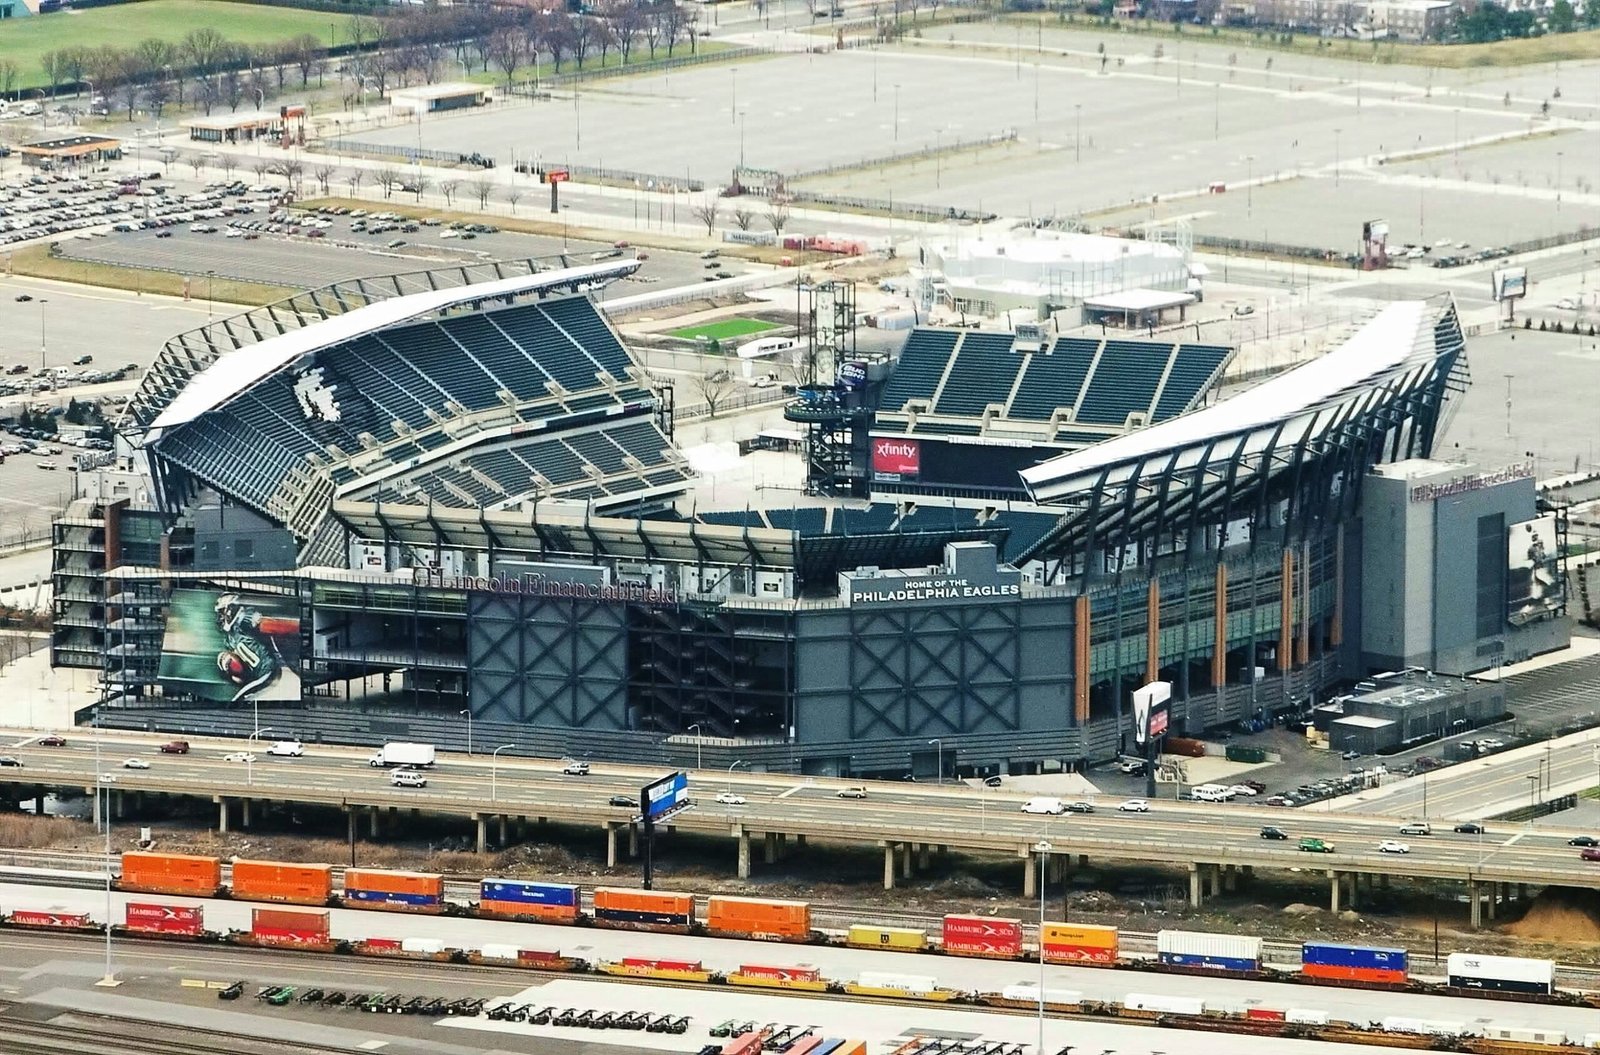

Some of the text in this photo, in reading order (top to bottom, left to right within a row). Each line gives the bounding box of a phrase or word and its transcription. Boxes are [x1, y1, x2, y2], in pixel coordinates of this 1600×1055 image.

[843, 365, 866, 375] BUD
[877, 442, 916, 458] xfinity
[438, 567, 679, 604] Lincoln Financial Field
[905, 581, 932, 589] HOME
[949, 579, 968, 587] THE
[853, 584, 1020, 603] PHILADELPHIA EAGLES
[129, 907, 194, 919] HAMBURG SÜD
[15, 914, 80, 927] HAMBURG SÜD
[947, 923, 1014, 936] HAMBURG SÜD
[255, 932, 290, 942] HAMBURG
[947, 941, 1014, 954] HAMBURG SÜD
[1042, 949, 1110, 961] HAMBURG SÜD
[744, 969, 811, 983] HAMBURG SÜD
